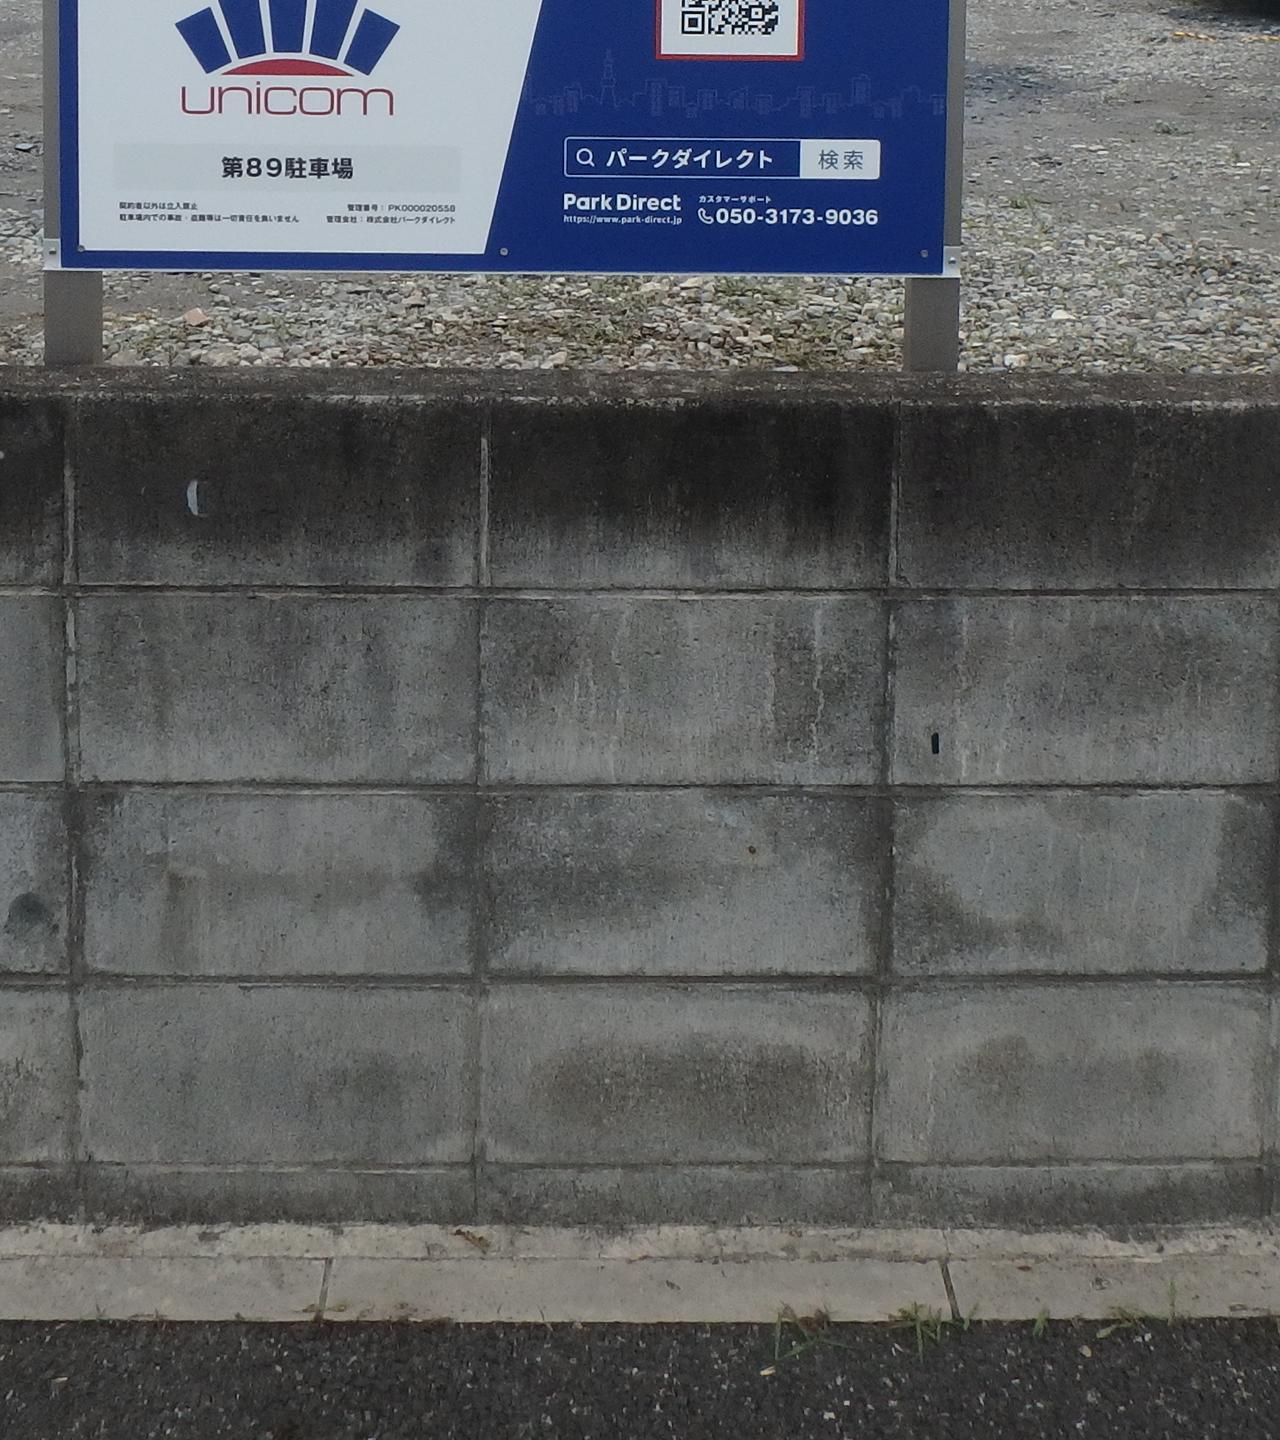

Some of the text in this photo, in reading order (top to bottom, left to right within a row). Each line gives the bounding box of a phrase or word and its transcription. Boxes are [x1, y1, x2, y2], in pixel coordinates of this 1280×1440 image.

[180, 81, 395, 117] unicom
[220, 155, 355, 181] 第89駐車場
[606, 148, 865, 171] パークダイレクト 検索
[563, 193, 682, 211] Park Direct
[698, 194, 772, 204] カスタマーサポート
[563, 215, 683, 225] https://www.park-direct.jp
[715, 207, 879, 225] 050-3173-9036
